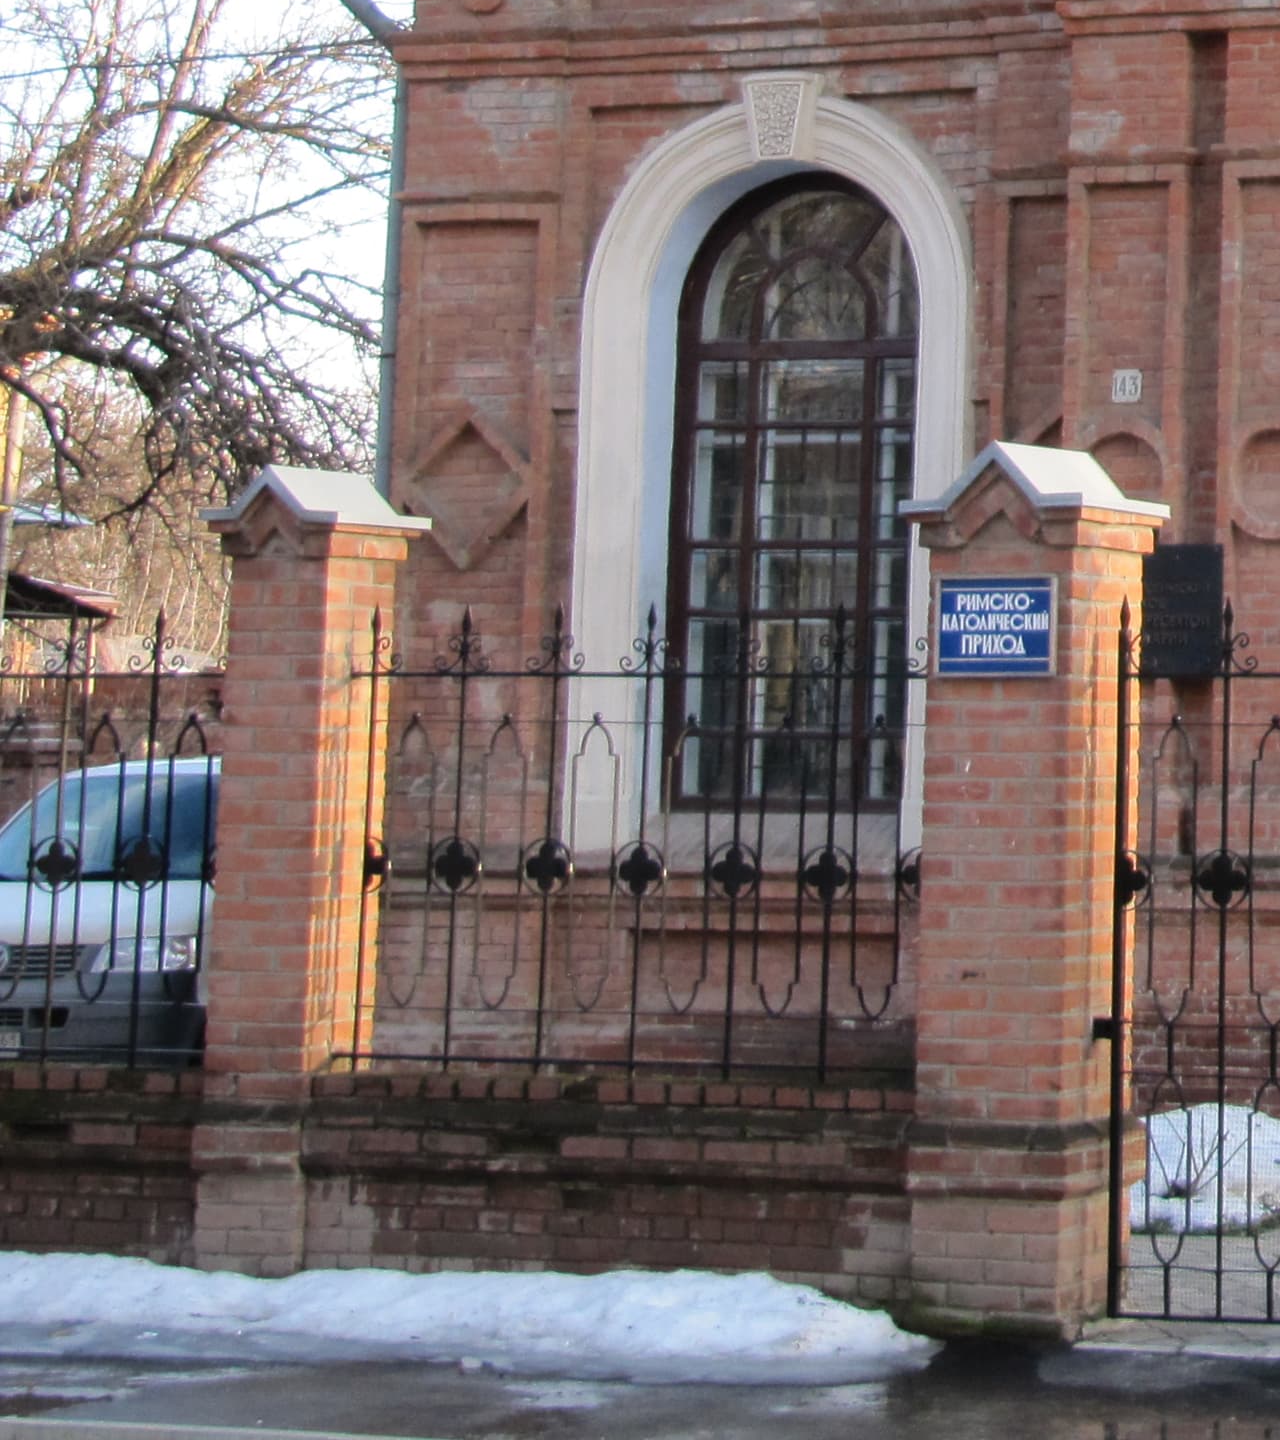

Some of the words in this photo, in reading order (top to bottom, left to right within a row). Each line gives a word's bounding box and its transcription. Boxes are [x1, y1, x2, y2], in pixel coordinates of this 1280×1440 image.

[1114, 375, 1139, 397] 143
[956, 592, 1035, 611] РИМСКО-
[941, 610, 1049, 631] КАТОЛИЧЕСКИЙ
[961, 633, 1027, 655] ПРИХОД
